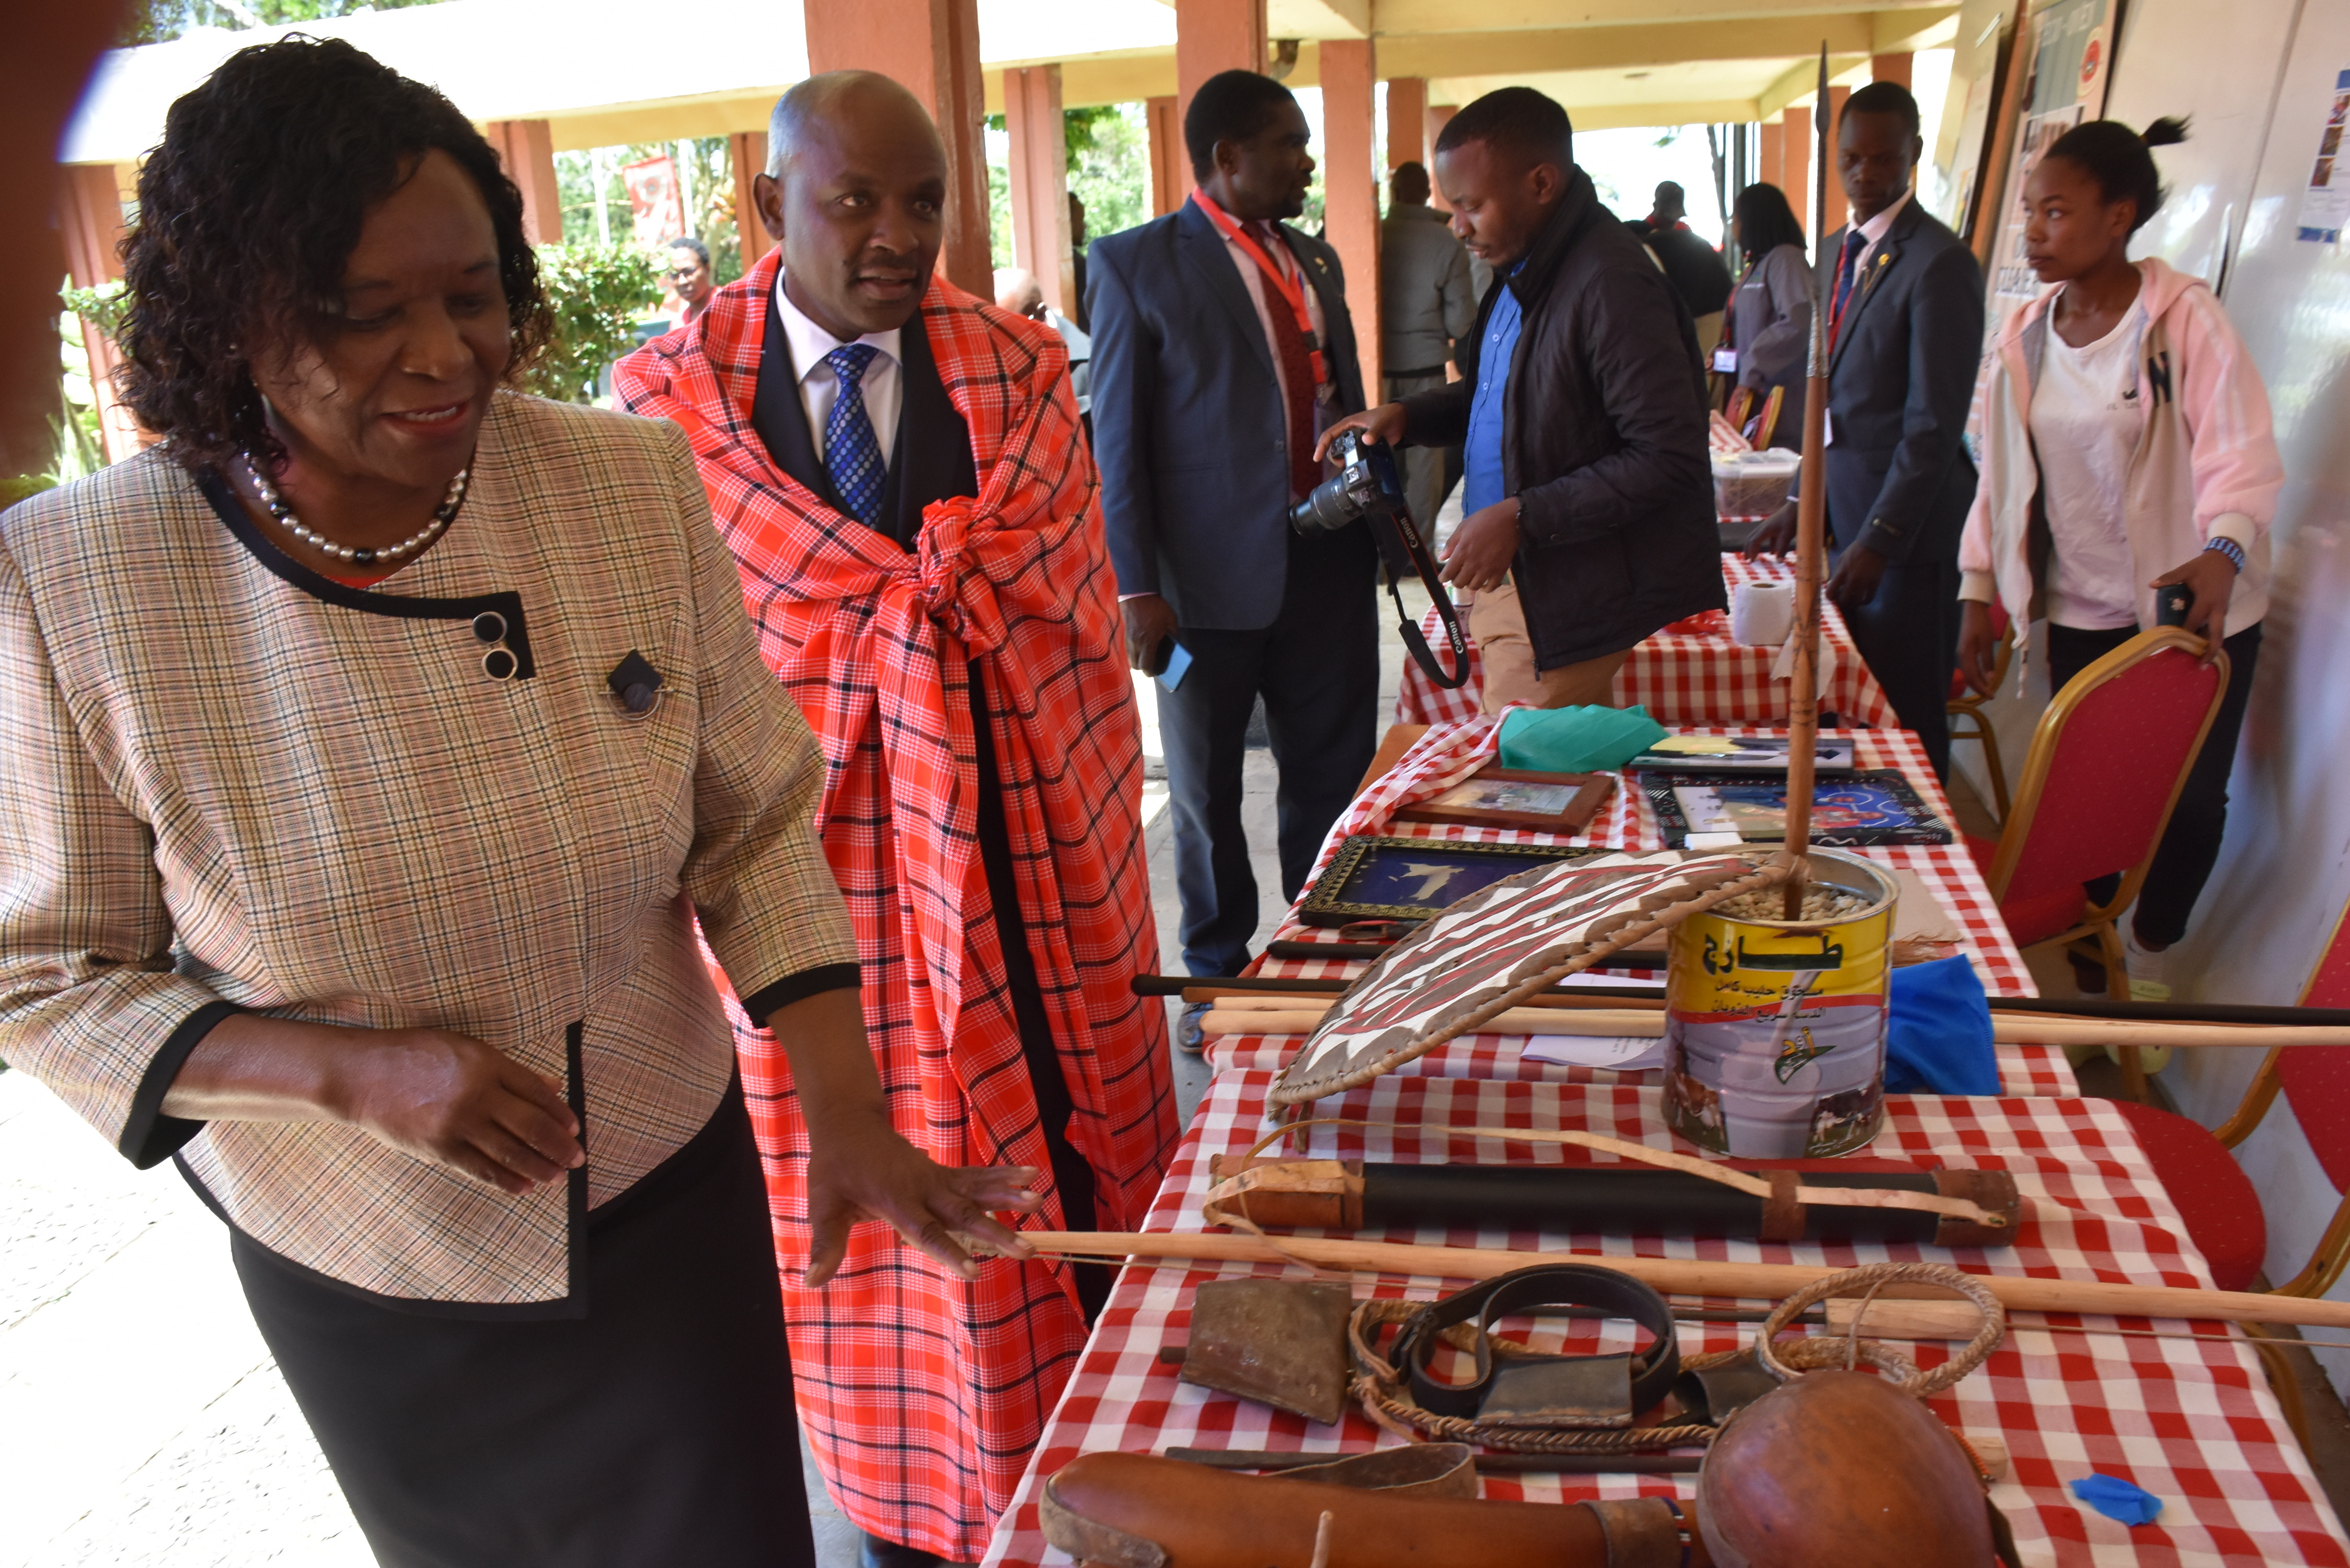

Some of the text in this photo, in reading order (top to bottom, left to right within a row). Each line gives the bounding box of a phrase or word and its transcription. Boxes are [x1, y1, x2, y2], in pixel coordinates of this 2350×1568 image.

[1400, 516, 1419, 549] Canon
[1448, 620, 1464, 654] Canon
[1715, 979, 1741, 991] كامل
[1744, 985, 1776, 999] حليب
[1755, 1009, 1788, 1023] سريع
